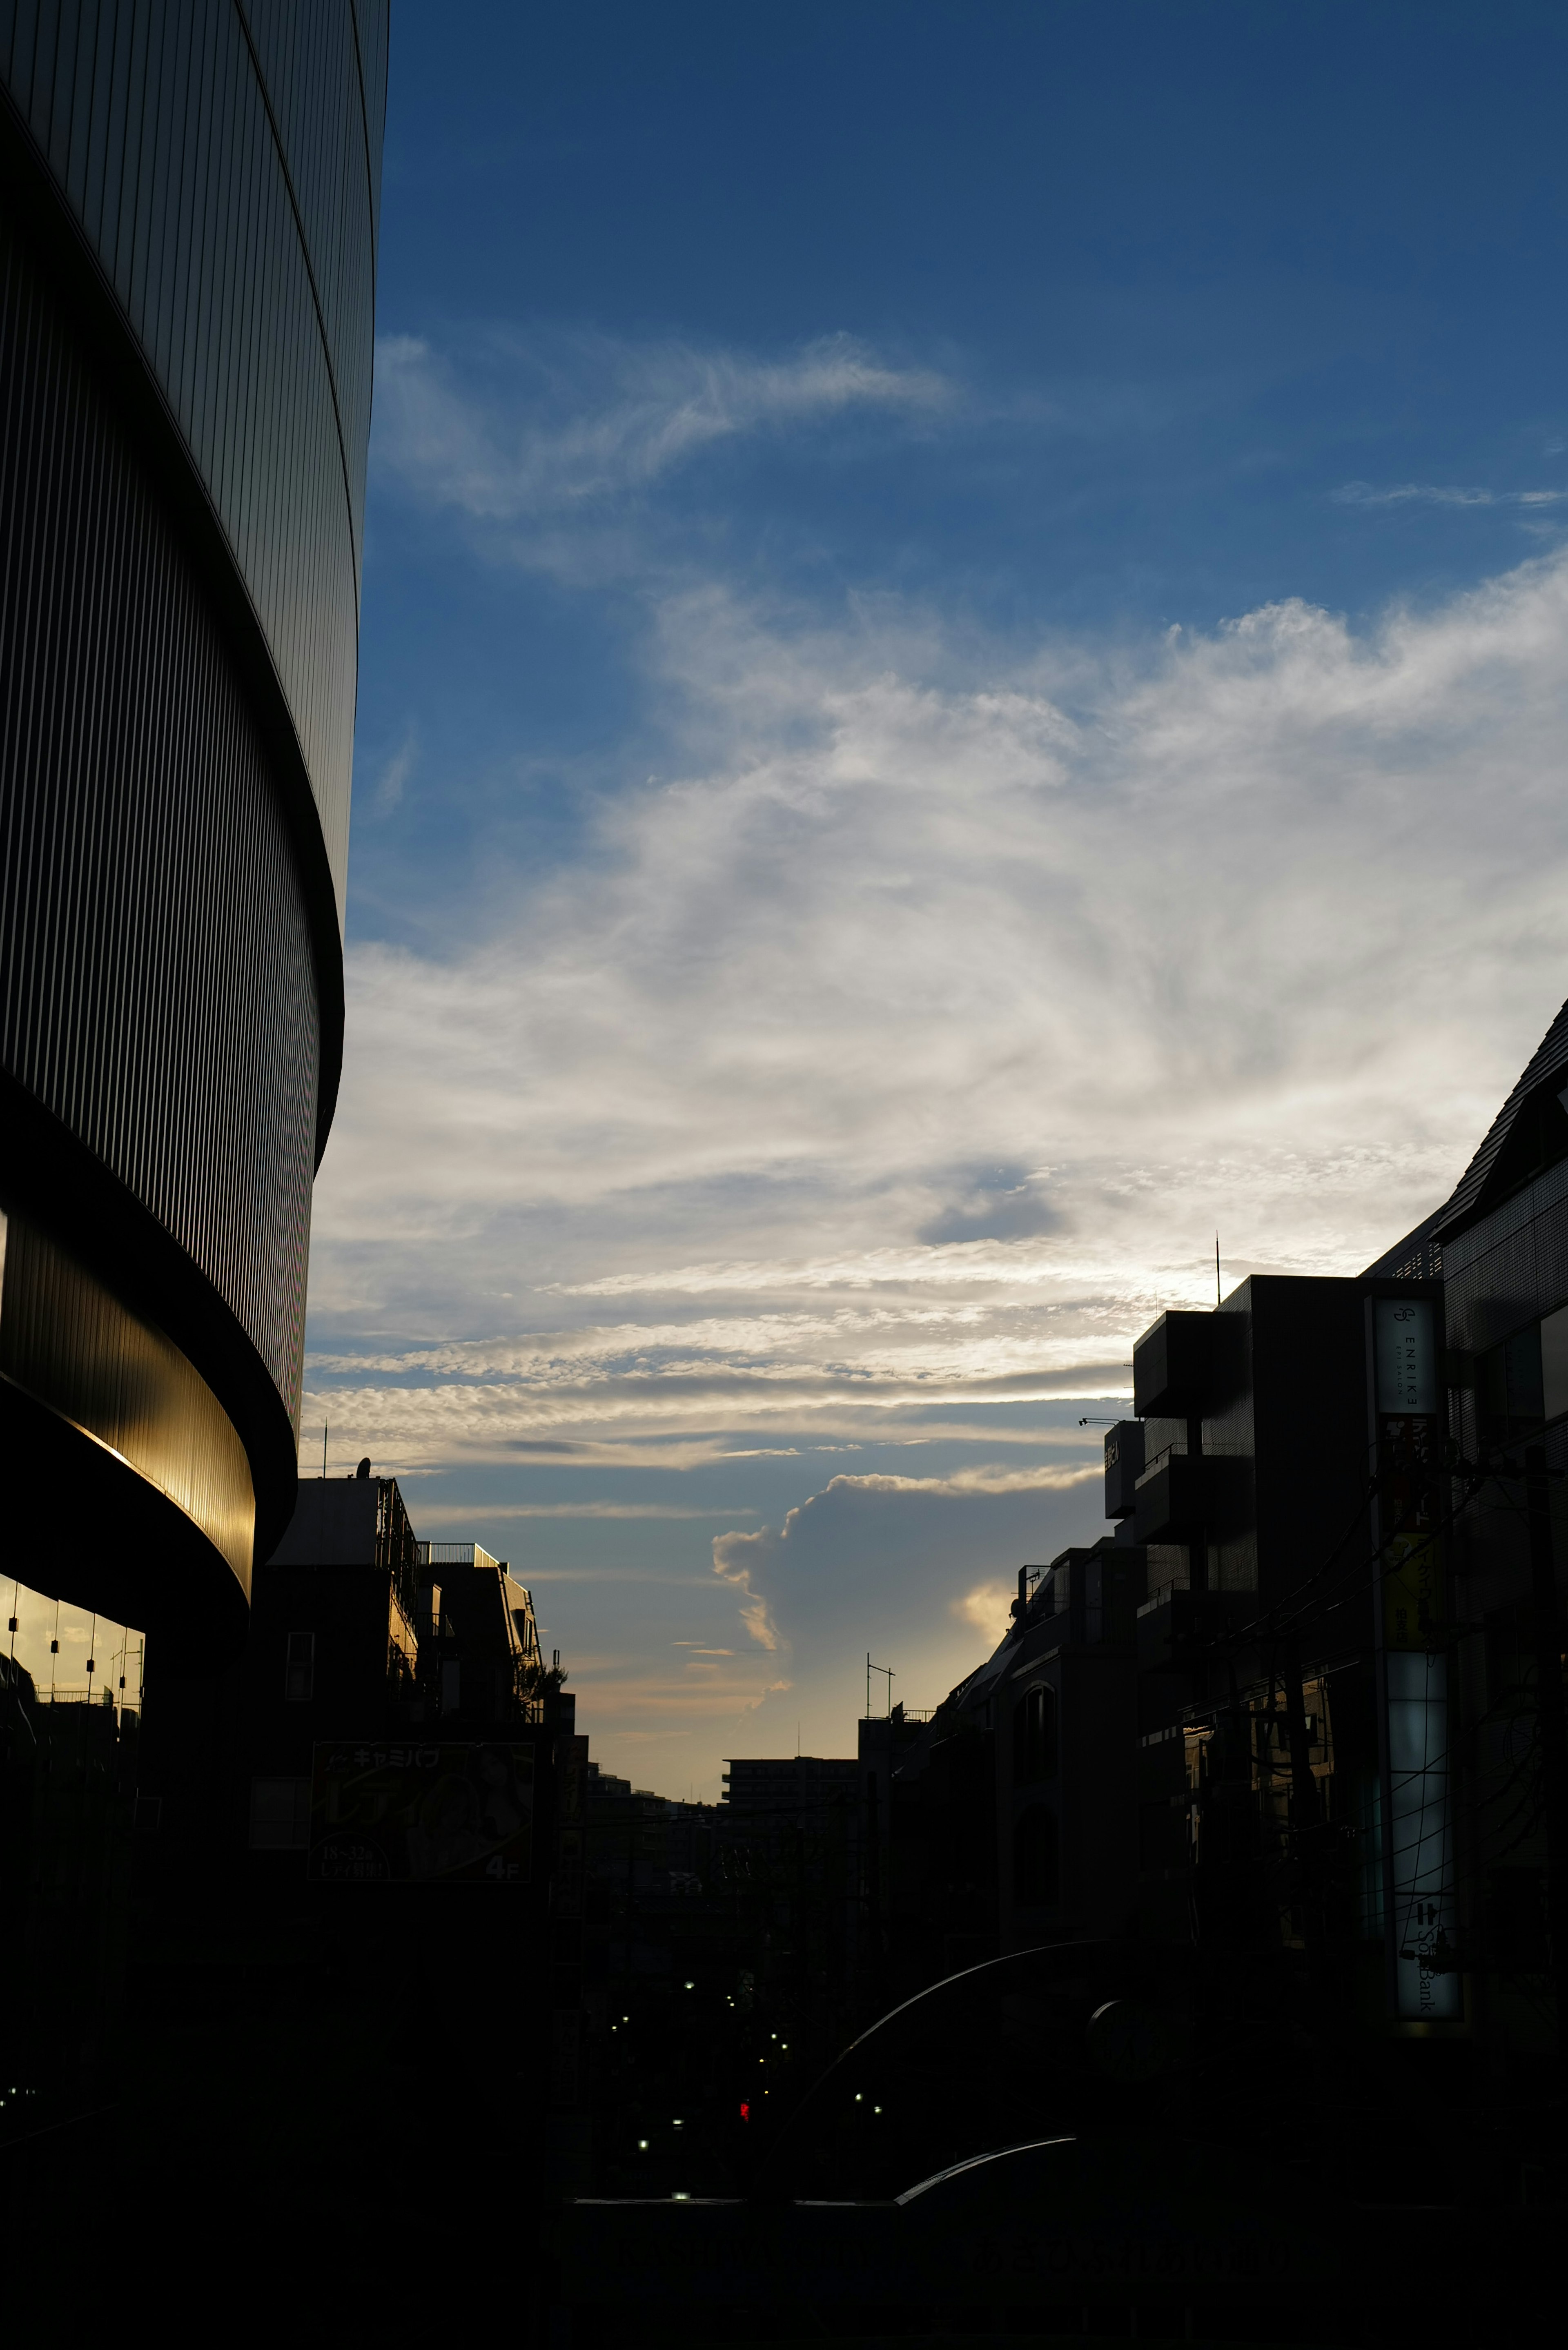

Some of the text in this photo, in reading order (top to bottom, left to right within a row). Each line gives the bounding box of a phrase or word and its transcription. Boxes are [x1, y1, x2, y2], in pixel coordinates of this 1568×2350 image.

[1395, 1608, 1408, 1644] 柏支店
[354, 1748, 440, 1768] キャミパブ
[486, 1855, 520, 1880] 4F
[1417, 1931, 1436, 2012] SoBank
[972, 2234, 1291, 2276] あさひふれあい通り
